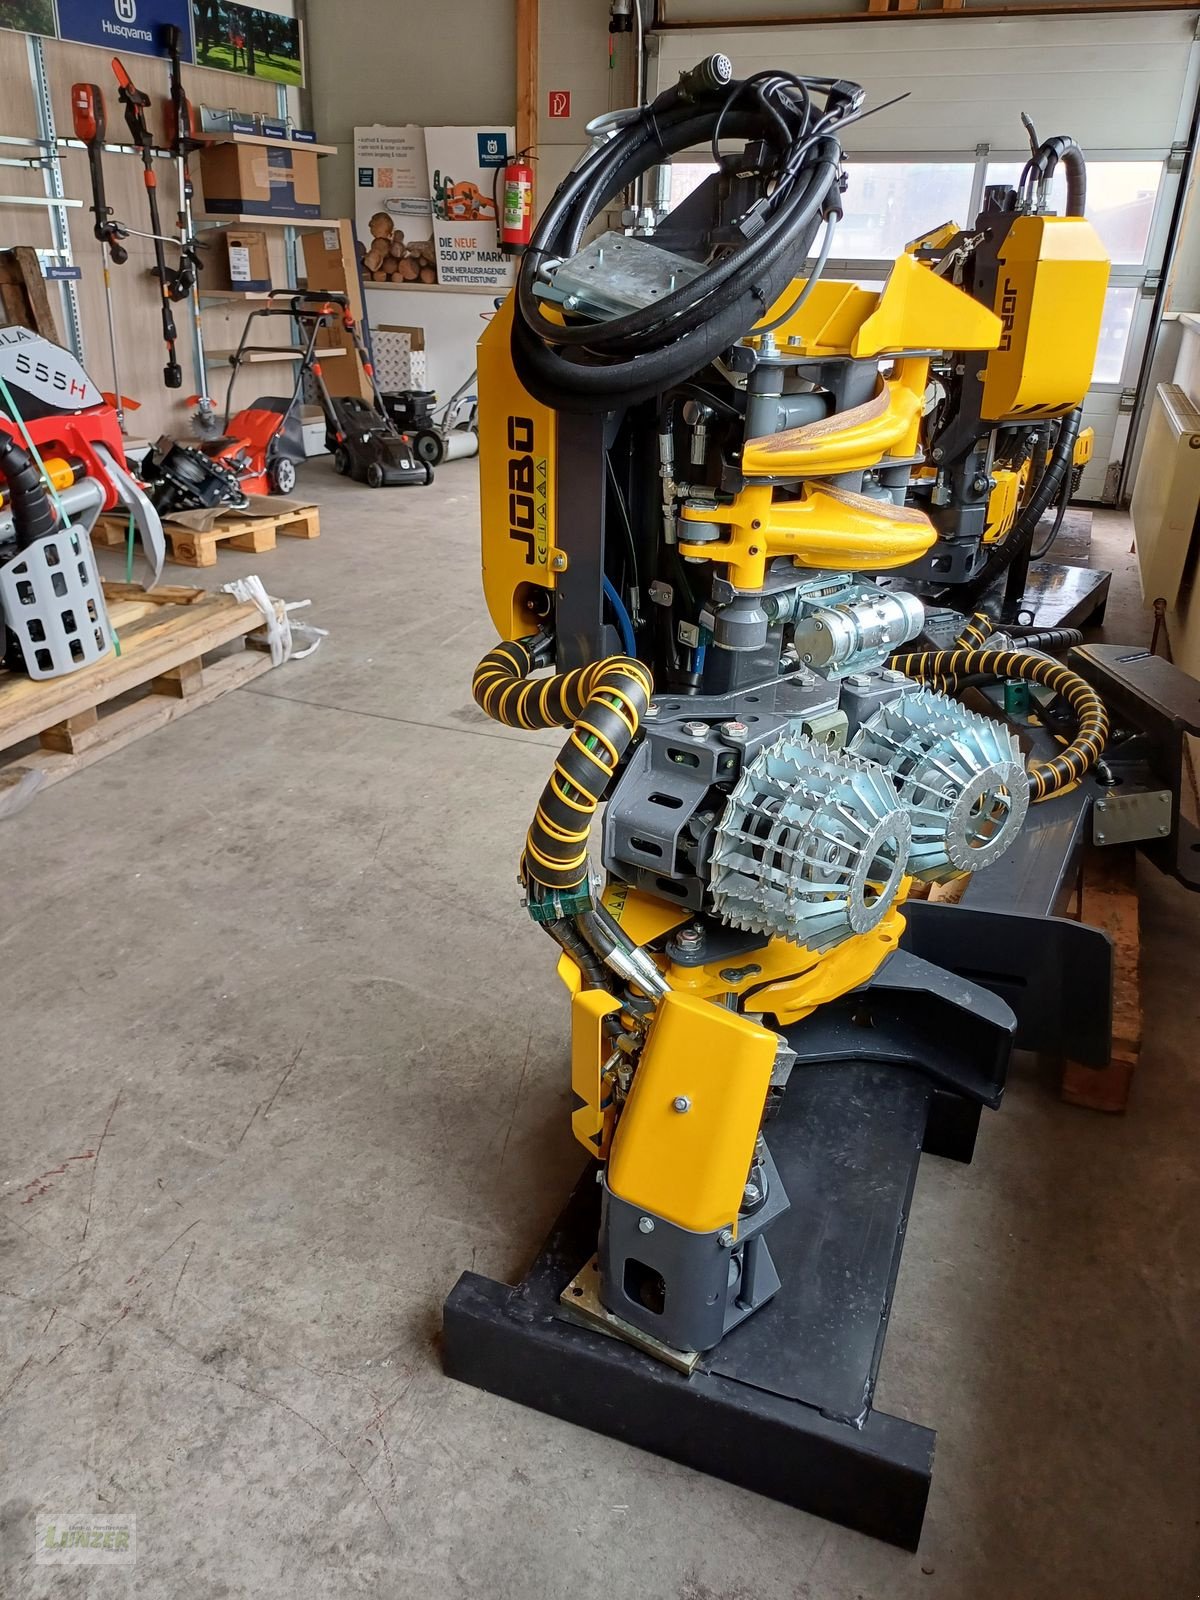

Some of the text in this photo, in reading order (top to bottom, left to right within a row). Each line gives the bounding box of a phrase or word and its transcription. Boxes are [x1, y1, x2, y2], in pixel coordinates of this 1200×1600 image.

[102, 19, 153, 42] Husqvarna
[439, 237, 477, 249] DIE NEUE
[440, 250, 458, 261] 550
[477, 251, 504, 263] MARK
[441, 266, 507, 276] EINE HERAUSRAGENDE
[15, 353, 87, 401] 555H
[507, 415, 535, 566] JOBO
